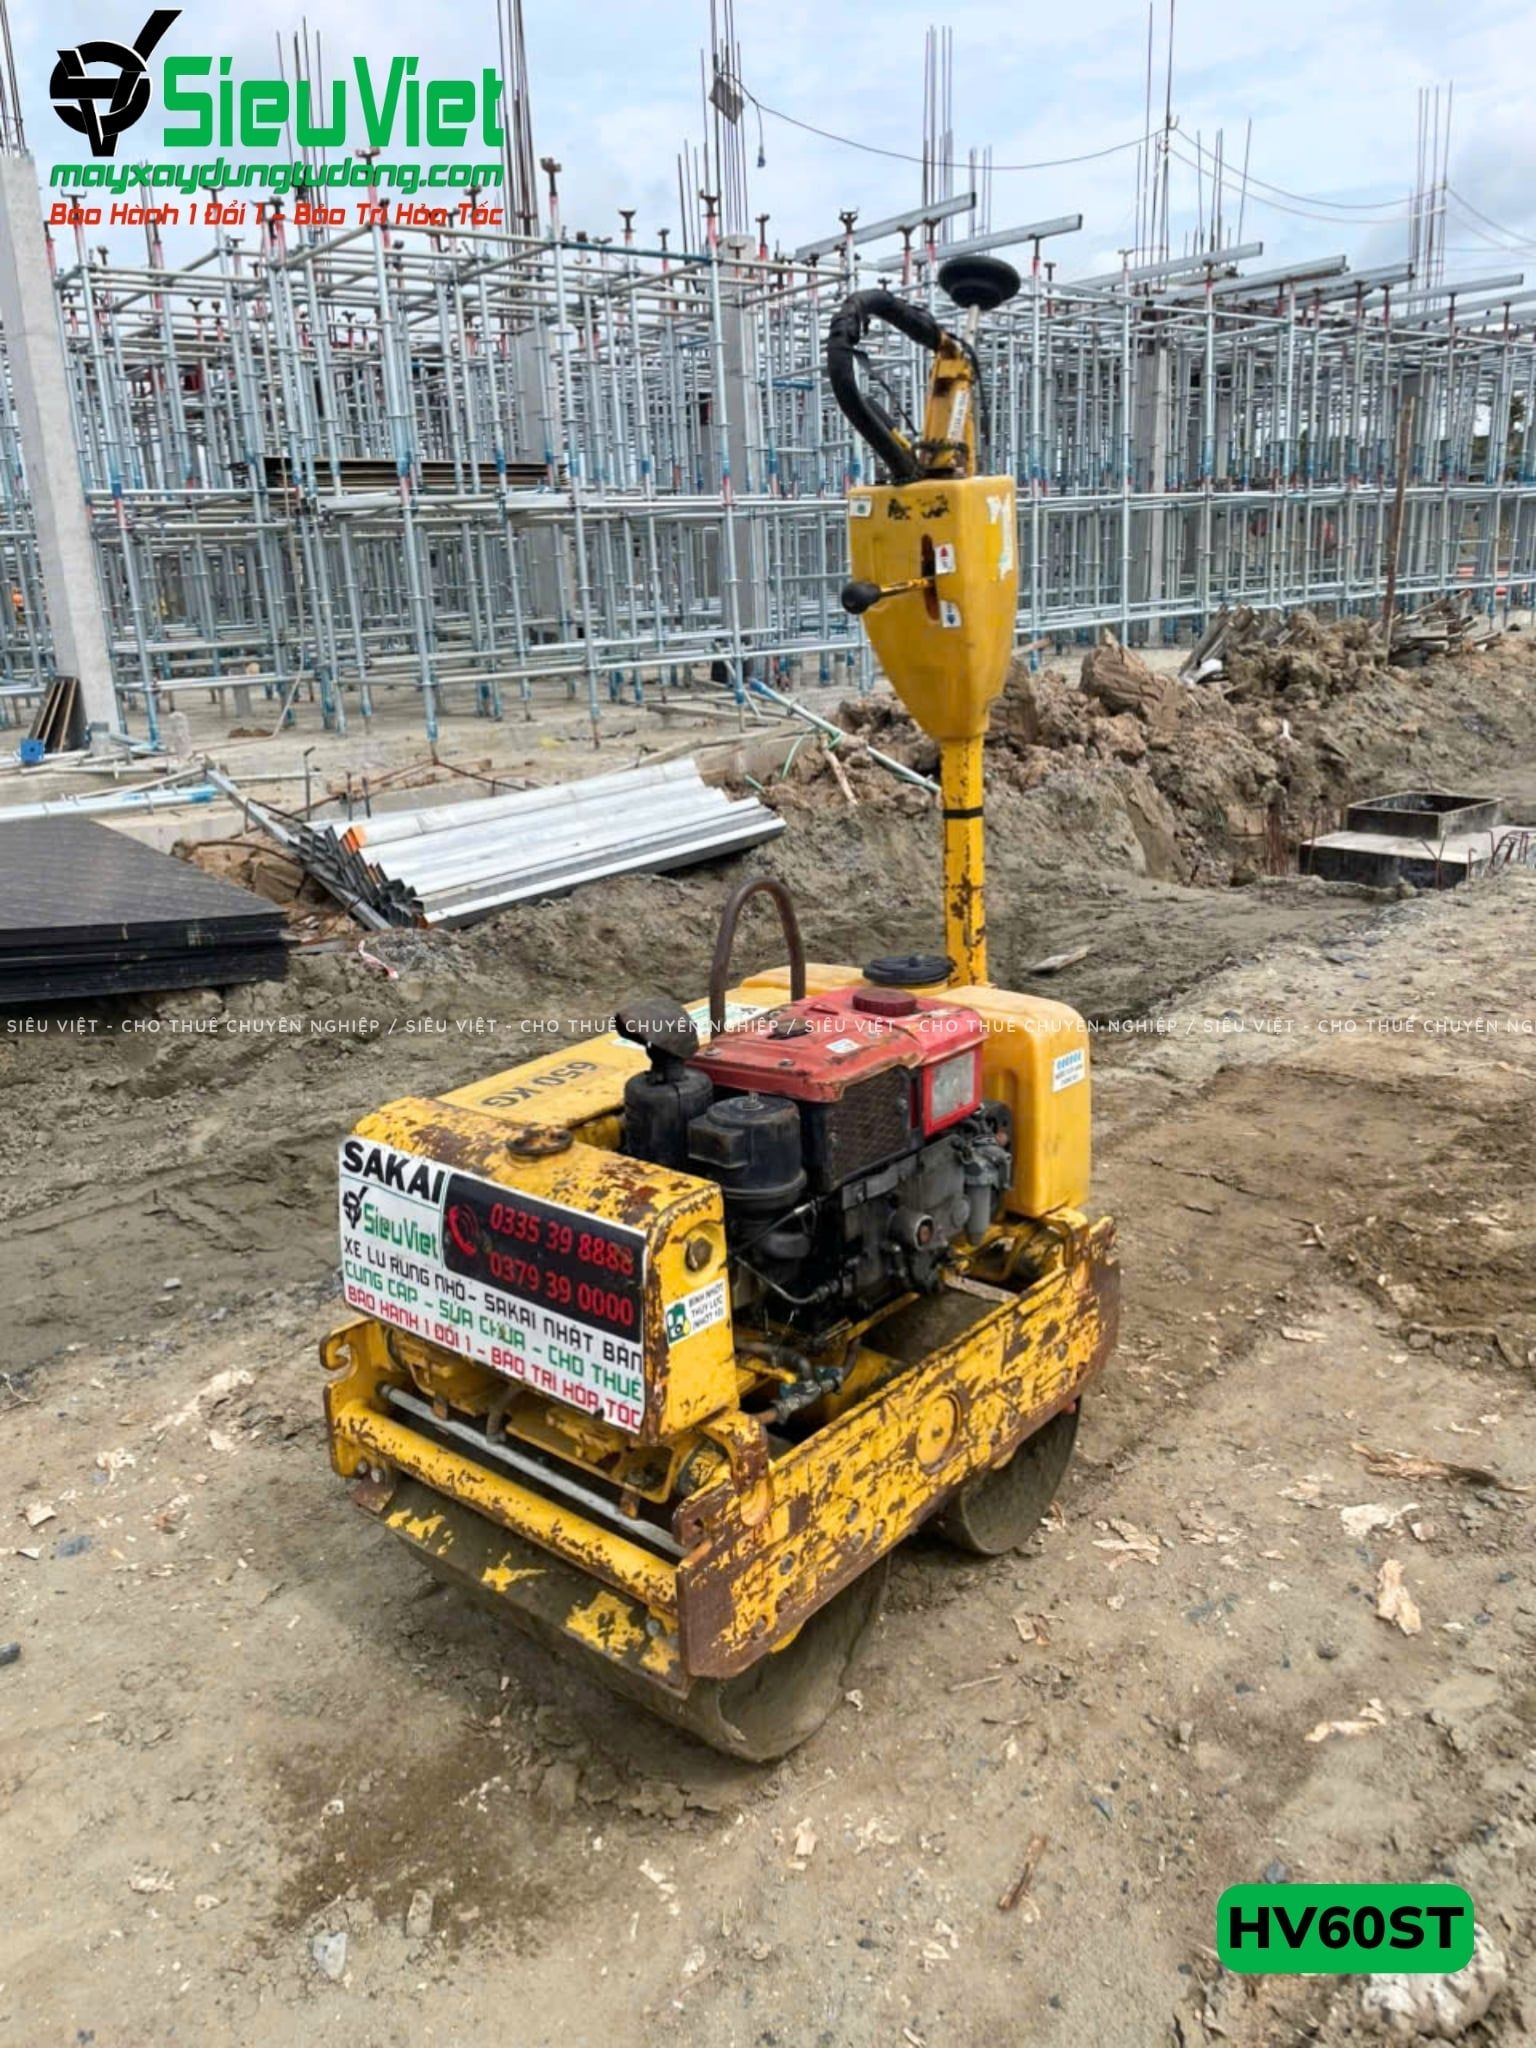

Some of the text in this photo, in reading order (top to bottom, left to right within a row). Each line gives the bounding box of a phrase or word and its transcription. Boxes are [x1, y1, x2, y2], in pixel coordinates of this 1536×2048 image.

[480, 1060, 599, 1108] 650 KG
[342, 1140, 446, 1205] SAKAI
[489, 1202, 635, 1277] 0335 39 8888
[344, 1235, 363, 1259] XE
[367, 1244, 386, 1269] LU
[389, 1254, 430, 1287] RUNG
[484, 1291, 537, 1331] SAKAI
[344, 1259, 384, 1293] CUNG
[548, 1344, 585, 1378] CHO
[489, 1250, 635, 1327] 0379 39 0000
